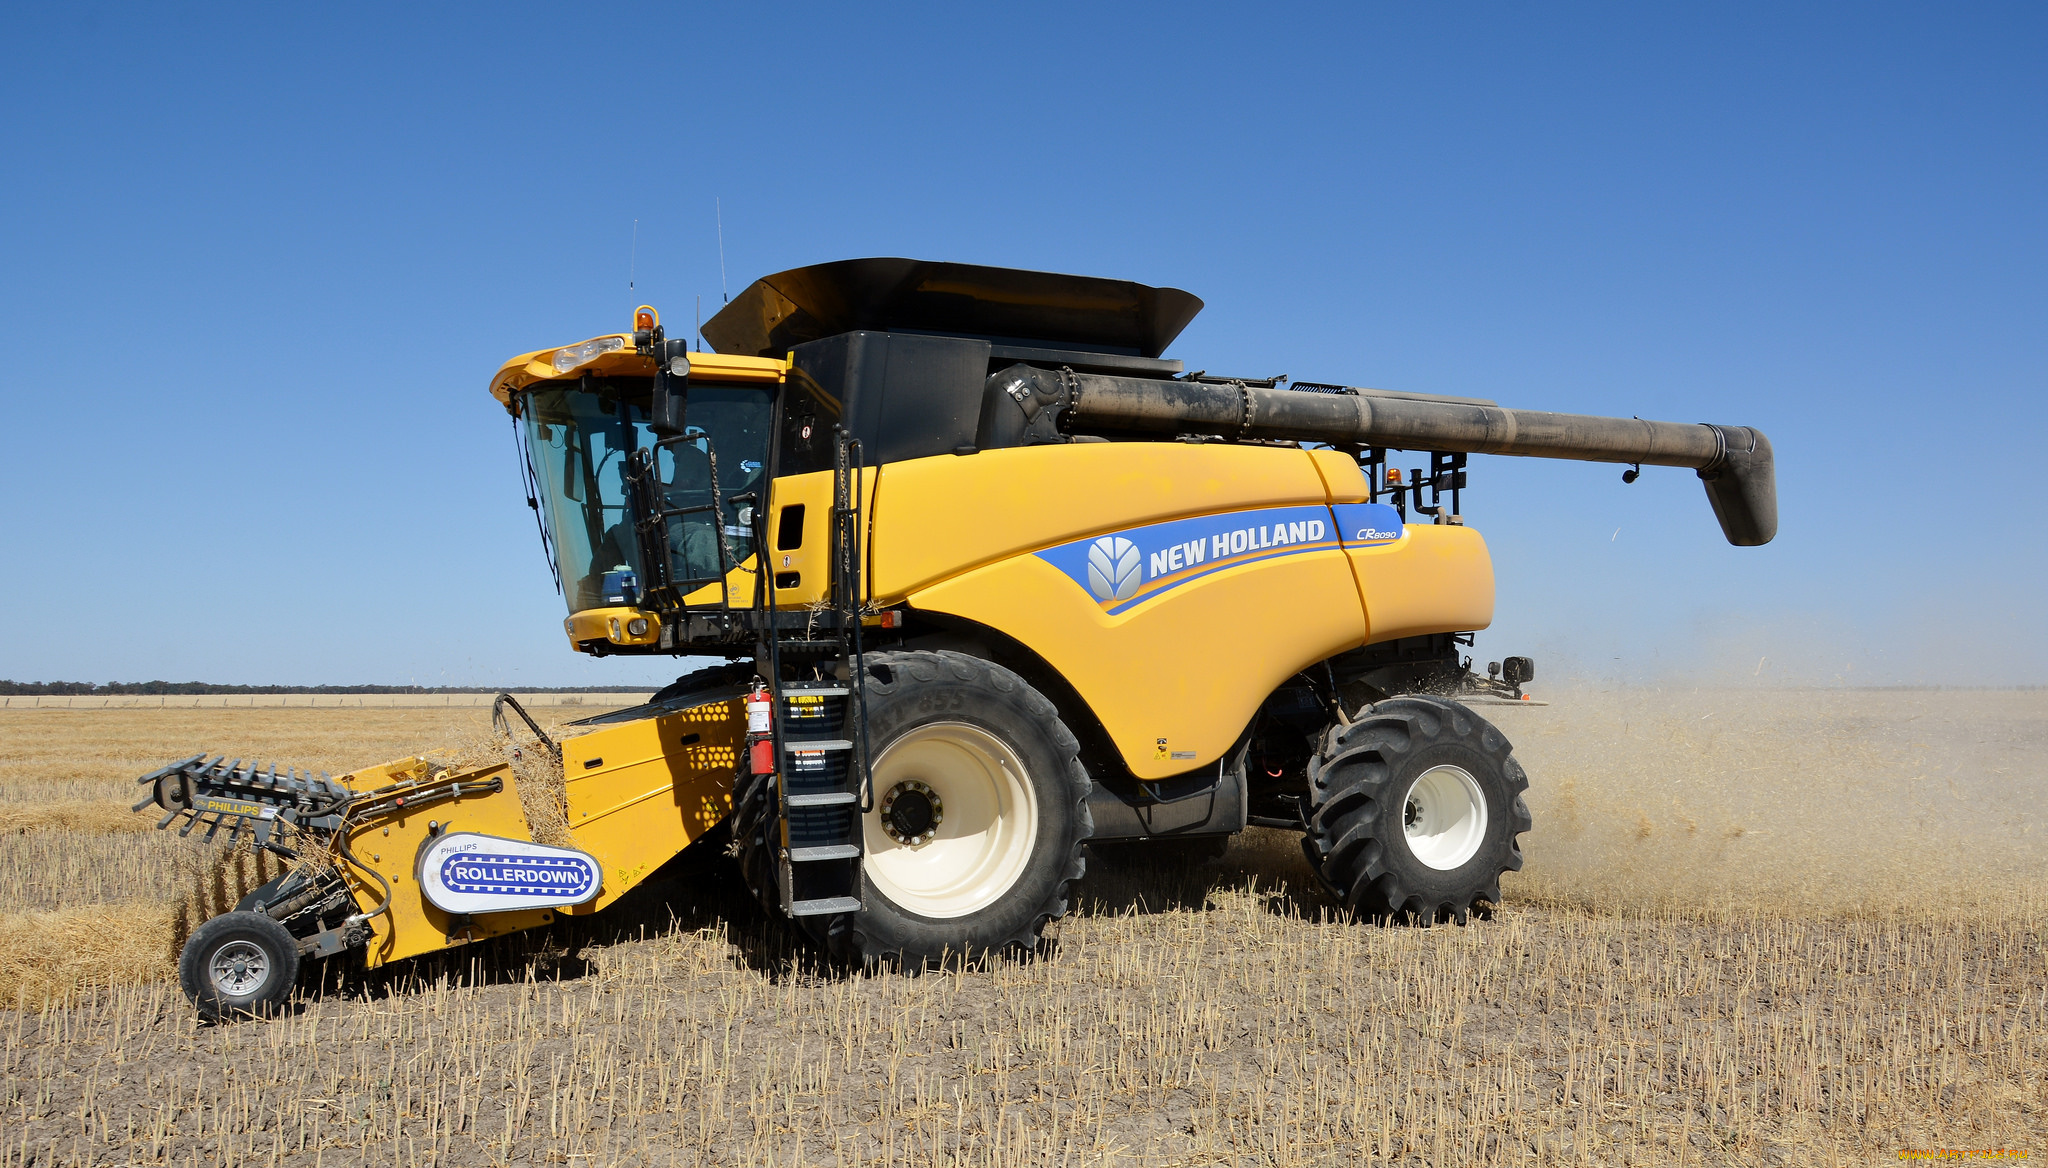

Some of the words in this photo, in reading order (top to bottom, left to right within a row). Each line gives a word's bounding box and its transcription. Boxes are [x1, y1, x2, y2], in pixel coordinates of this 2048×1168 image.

[1356, 528, 1397, 540] CR8090
[1150, 537, 1207, 578] NEW
[1212, 520, 1325, 559] HOLLAND
[918, 687, 964, 713] 855
[207, 800, 260, 816] PHILLIPS
[440, 843, 478, 855] PHILLIPS
[455, 866, 580, 884] ROLLERDOWN
